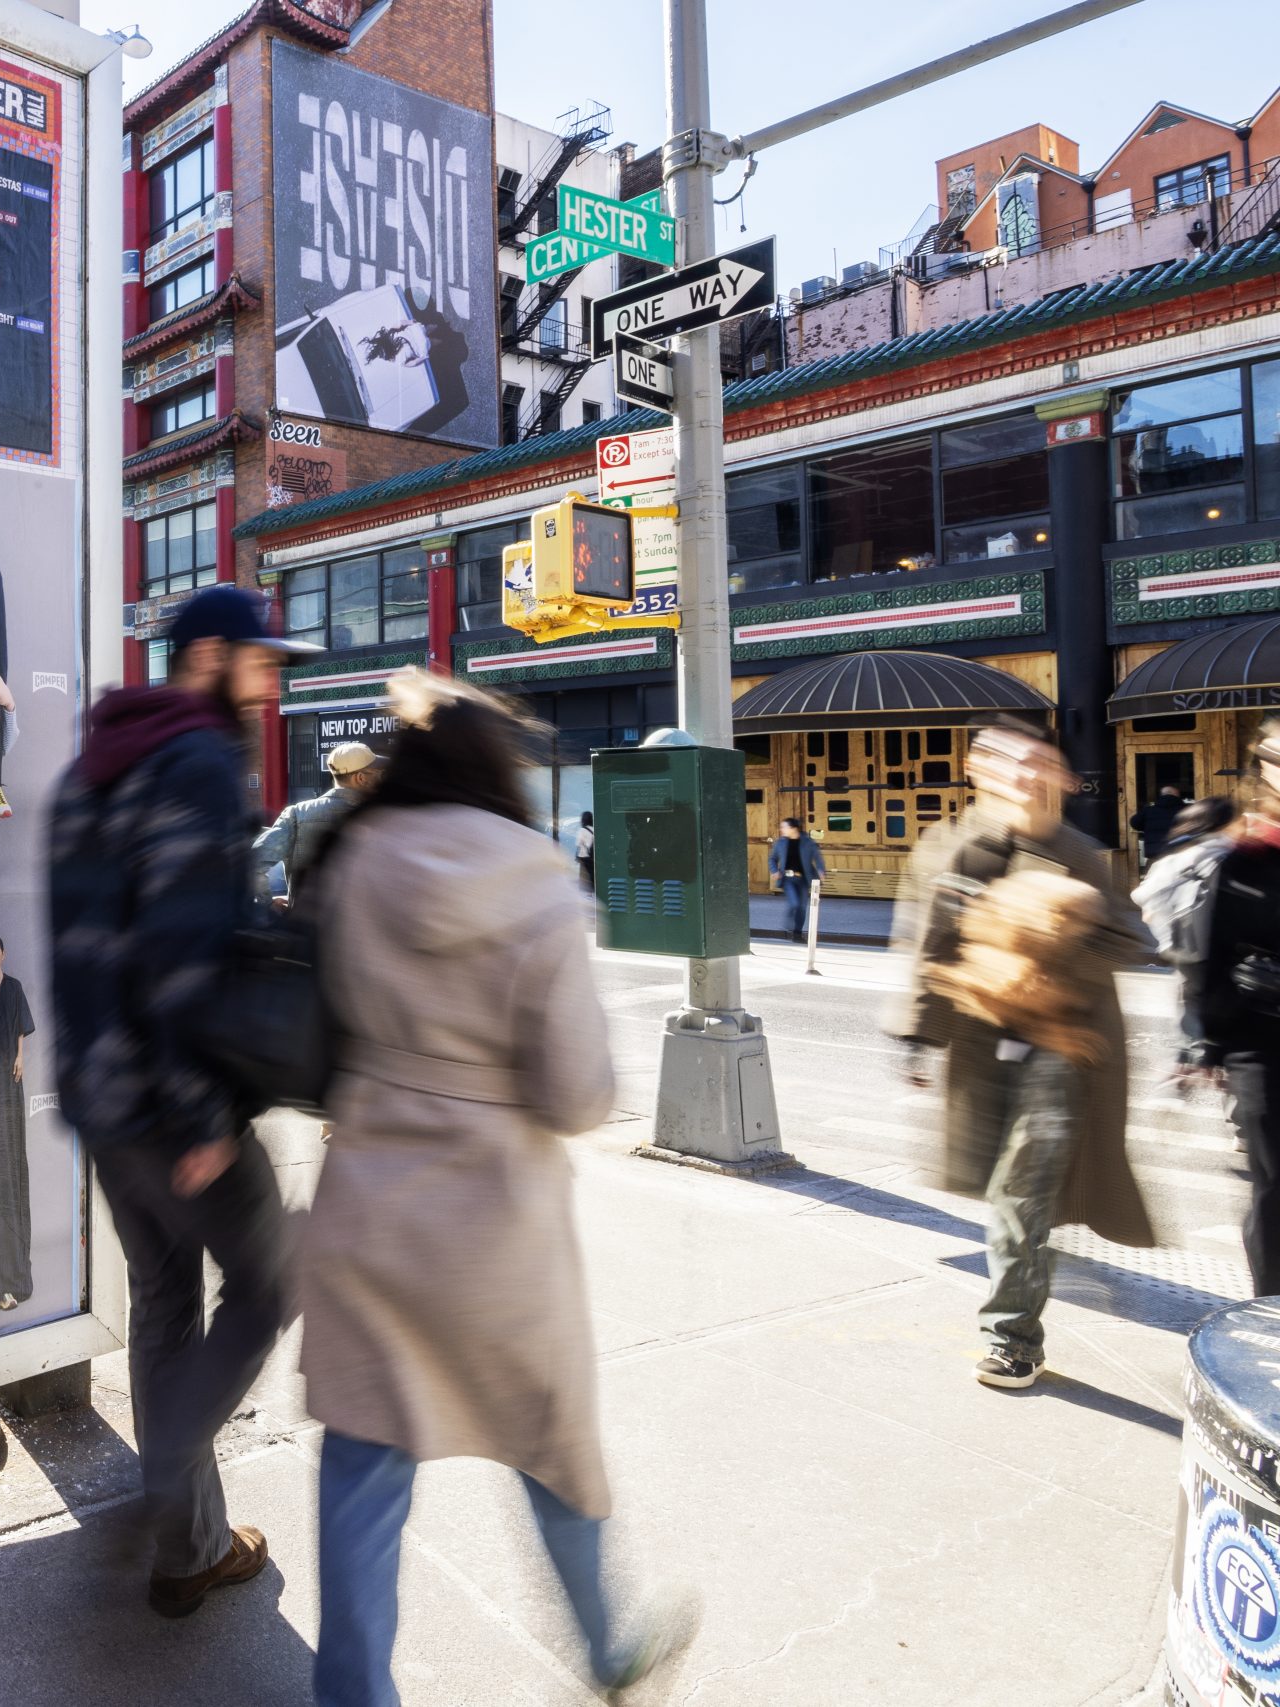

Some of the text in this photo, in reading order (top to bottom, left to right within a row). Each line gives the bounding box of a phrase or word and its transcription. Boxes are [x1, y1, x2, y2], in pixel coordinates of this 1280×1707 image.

[27, 94, 44, 128] HALL
[565, 192, 674, 252] HESTER ST
[616, 269, 744, 332] ONE WAY
[628, 356, 657, 387] ONE
[270, 420, 321, 447] seen
[634, 450, 660, 461] Except
[653, 533, 672, 543] 7pm
[644, 545, 677, 557] Sunday
[34, 674, 66, 688] CAMPER
[1173, 688, 1261, 710] SOUTH
[322, 720, 345, 736] NEW
[346, 718, 368, 736] TOP
[32, 1095, 62, 1112] CAMPE
[1228, 1552, 1265, 1602] FCZ
